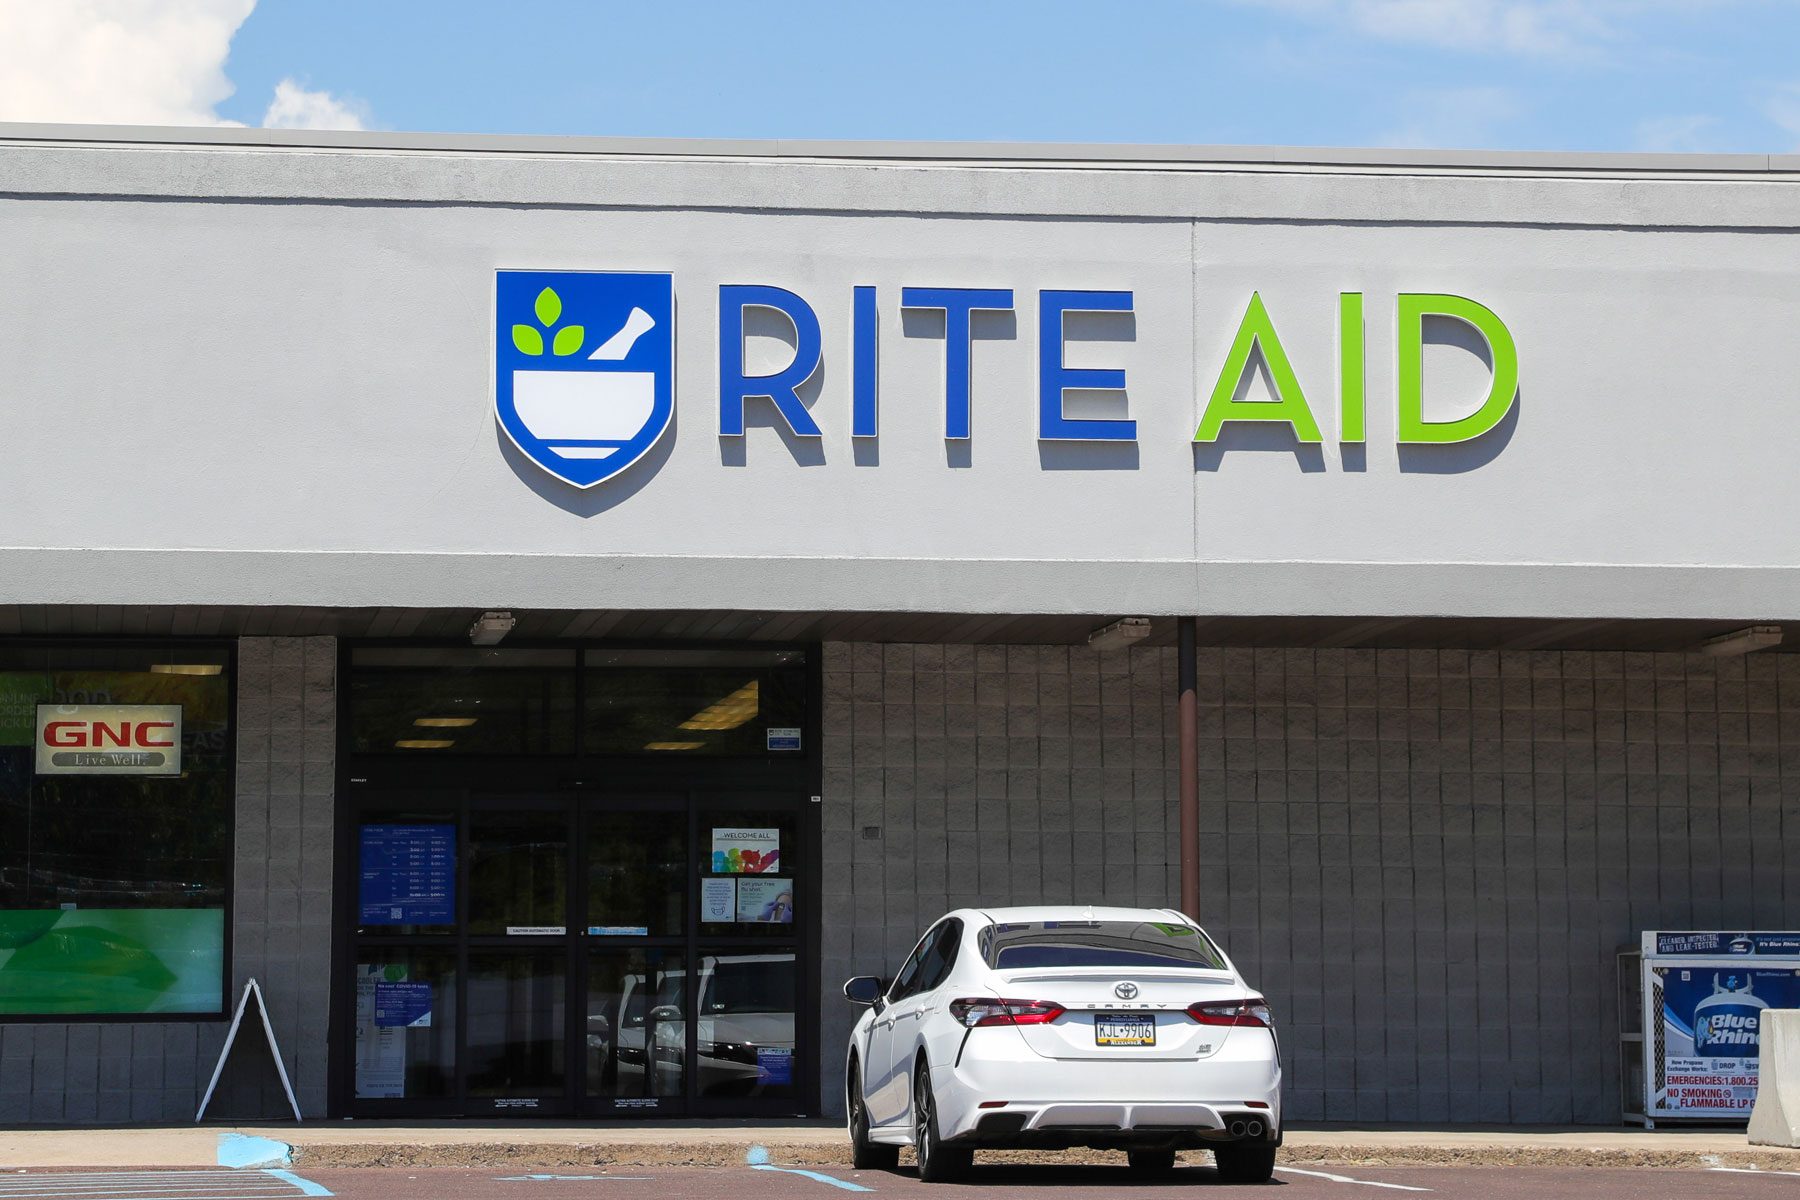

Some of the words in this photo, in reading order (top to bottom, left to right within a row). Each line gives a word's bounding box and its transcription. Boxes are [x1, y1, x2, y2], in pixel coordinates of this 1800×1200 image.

[718, 284, 1137, 442] RITE
[1193, 290, 1519, 446] AID
[43, 721, 175, 747] GNC
[75, 753, 107, 765] Live
[1711, 1014, 1757, 1029] Blue
[1667, 1088, 1679, 1098] NO
[1681, 1088, 1722, 1099] SMOKING
[1680, 1098, 1735, 1108] FLAMMABLE
[1737, 1099, 1748, 1109] LP
